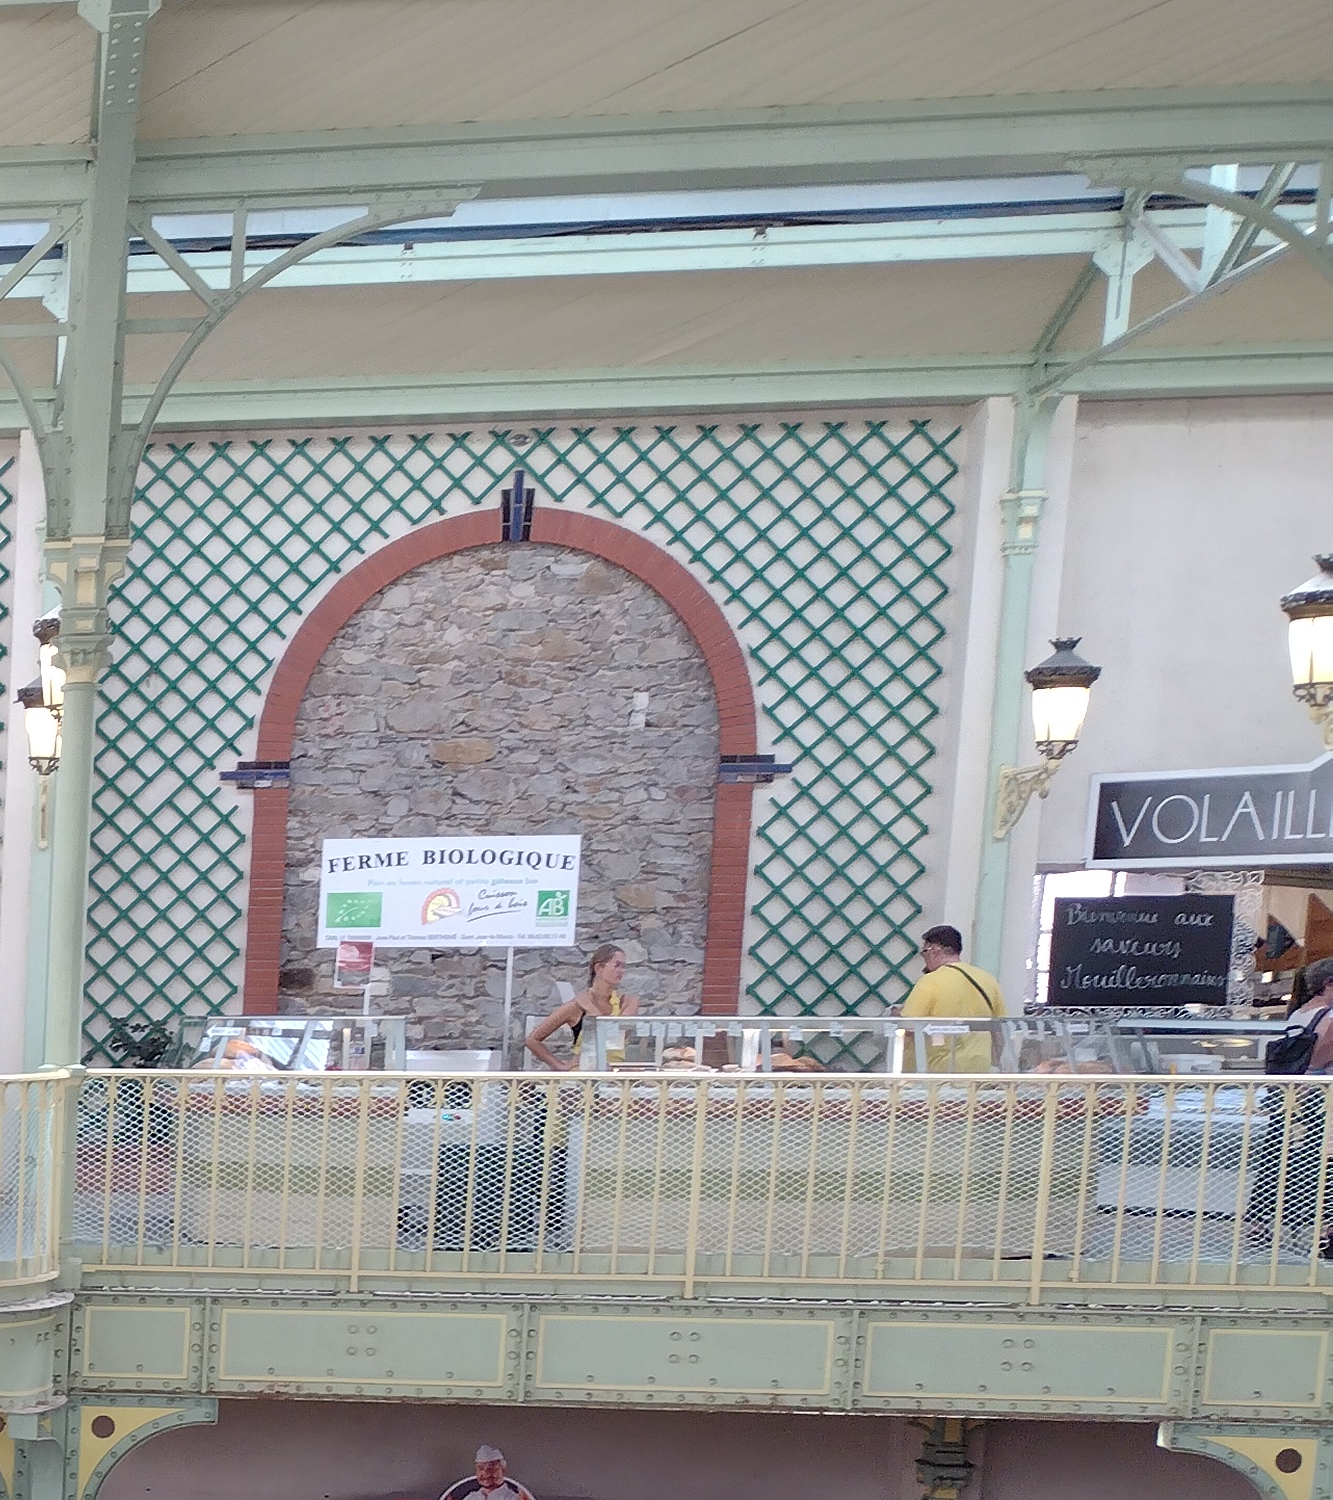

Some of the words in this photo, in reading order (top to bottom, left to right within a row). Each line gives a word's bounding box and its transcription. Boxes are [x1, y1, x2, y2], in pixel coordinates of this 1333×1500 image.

[1111, 789, 1333, 847] VOLAILL
[327, 851, 410, 874] FERME
[421, 848, 576, 872] BIOLOGIQUE
[538, 897, 566, 917] AB
[1174, 911, 1214, 927] aux
